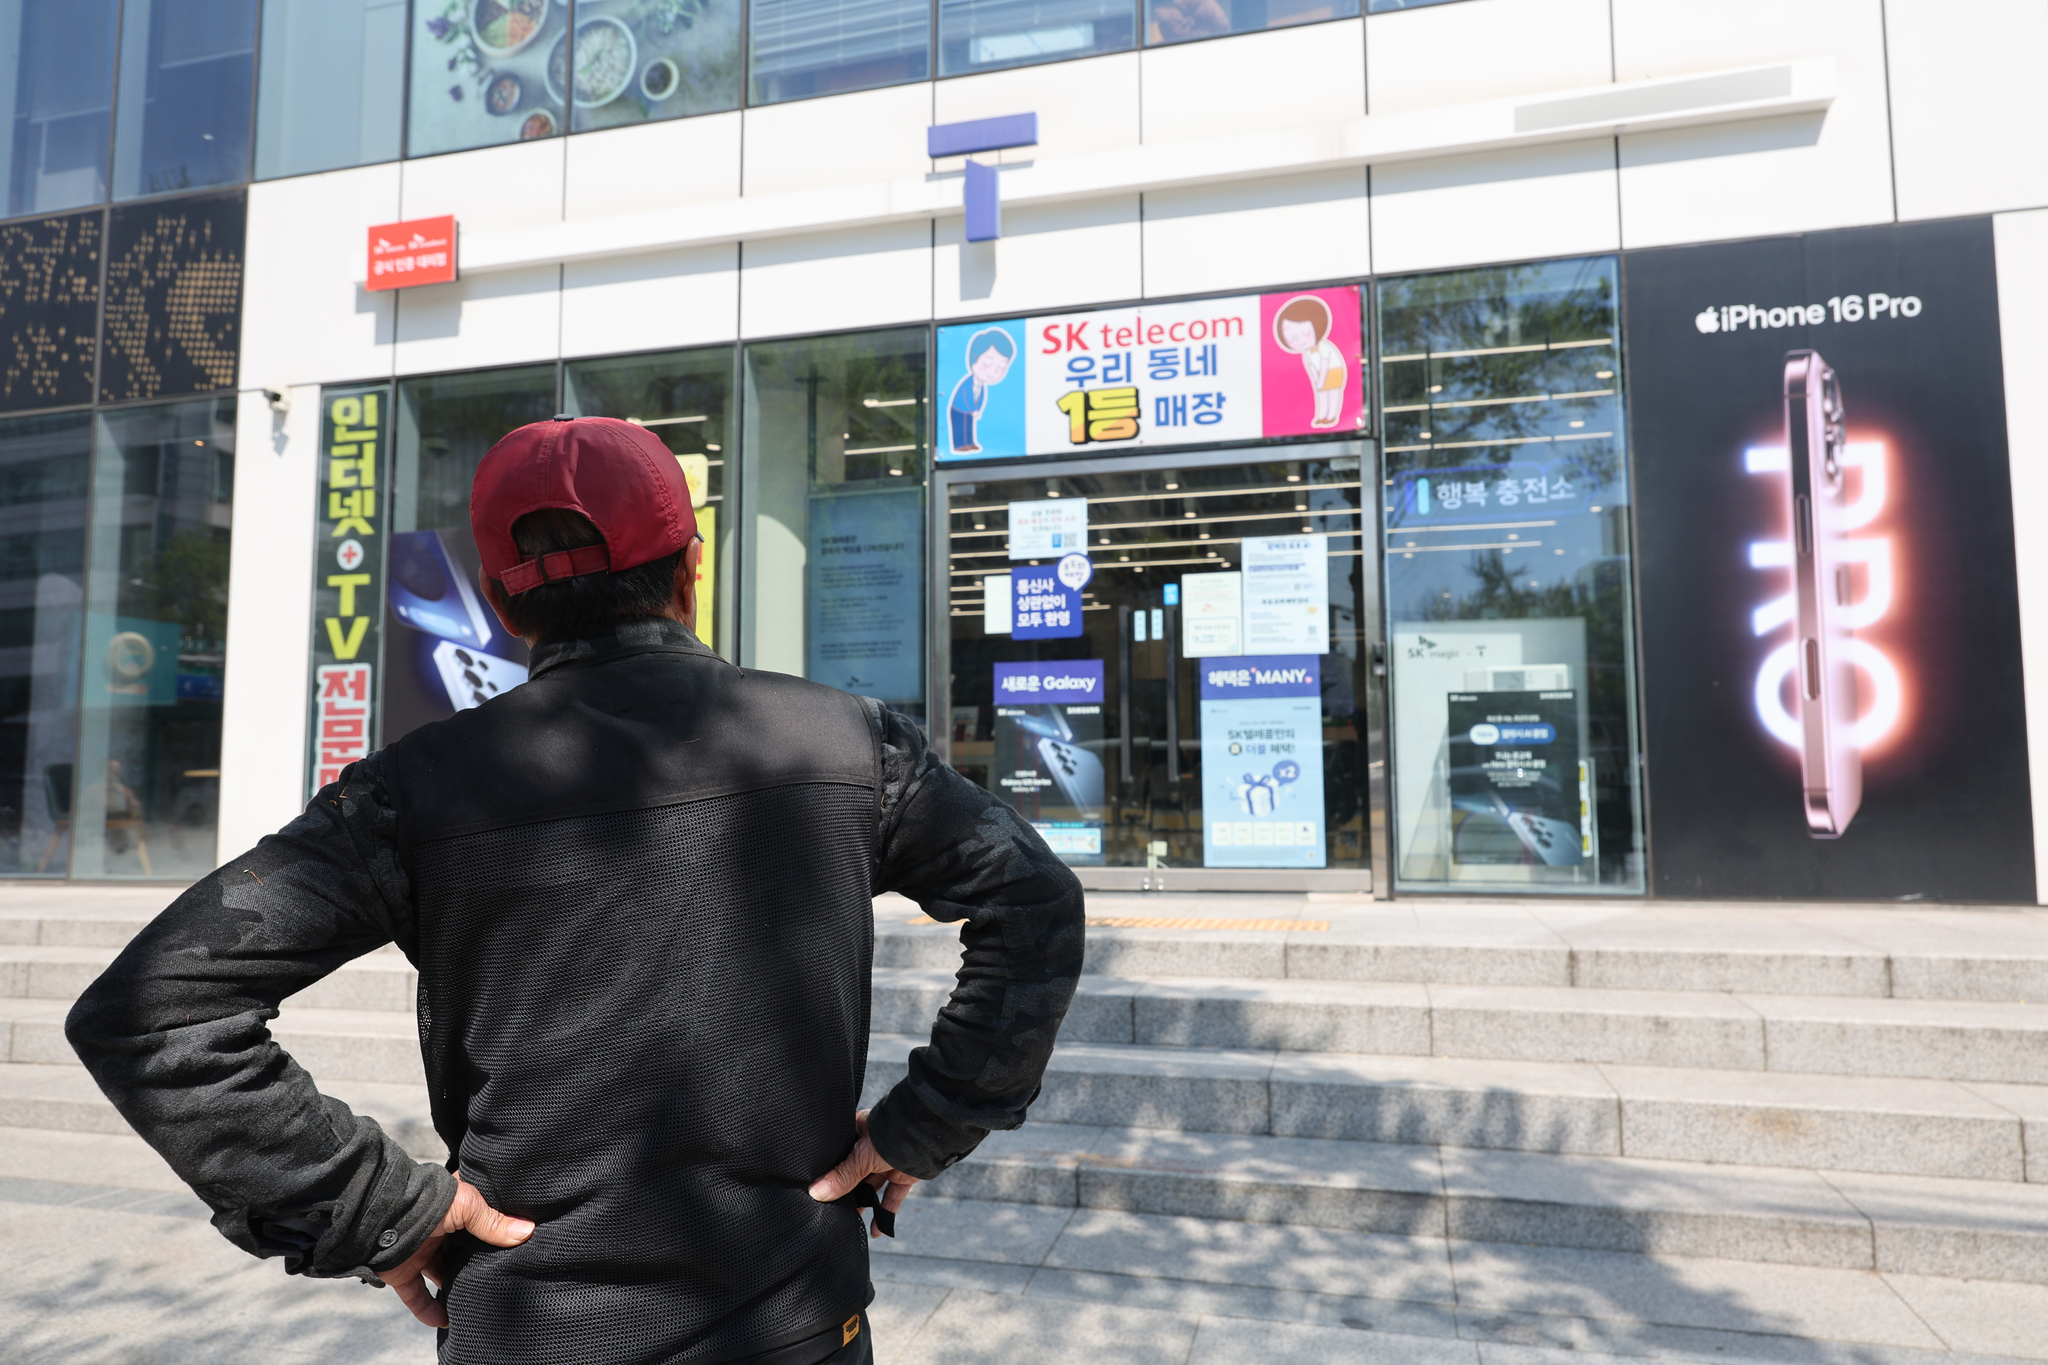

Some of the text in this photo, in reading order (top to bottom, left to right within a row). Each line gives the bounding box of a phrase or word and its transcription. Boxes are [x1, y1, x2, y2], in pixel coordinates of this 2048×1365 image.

[1720, 292, 1922, 332] iPhone 16 Pro
[1041, 314, 1244, 355] SK telecom
[1065, 344, 1218, 388] 우리 동네
[1056, 386, 1226, 445] 1등 매장
[328, 394, 379, 537] 인터넷
[1436, 474, 1577, 510] 행복 충전소
[1016, 577, 1055, 595] 통신사
[1017, 593, 1066, 612] 상관없이
[324, 574, 371, 661] TV
[1017, 610, 1070, 628] 모두 환영
[1407, 648, 1425, 659] SK
[1001, 675, 1097, 693] 새로운 Galaxy
[1208, 668, 1307, 688] 혜택은 MANY
[318, 669, 368, 790] 전문
